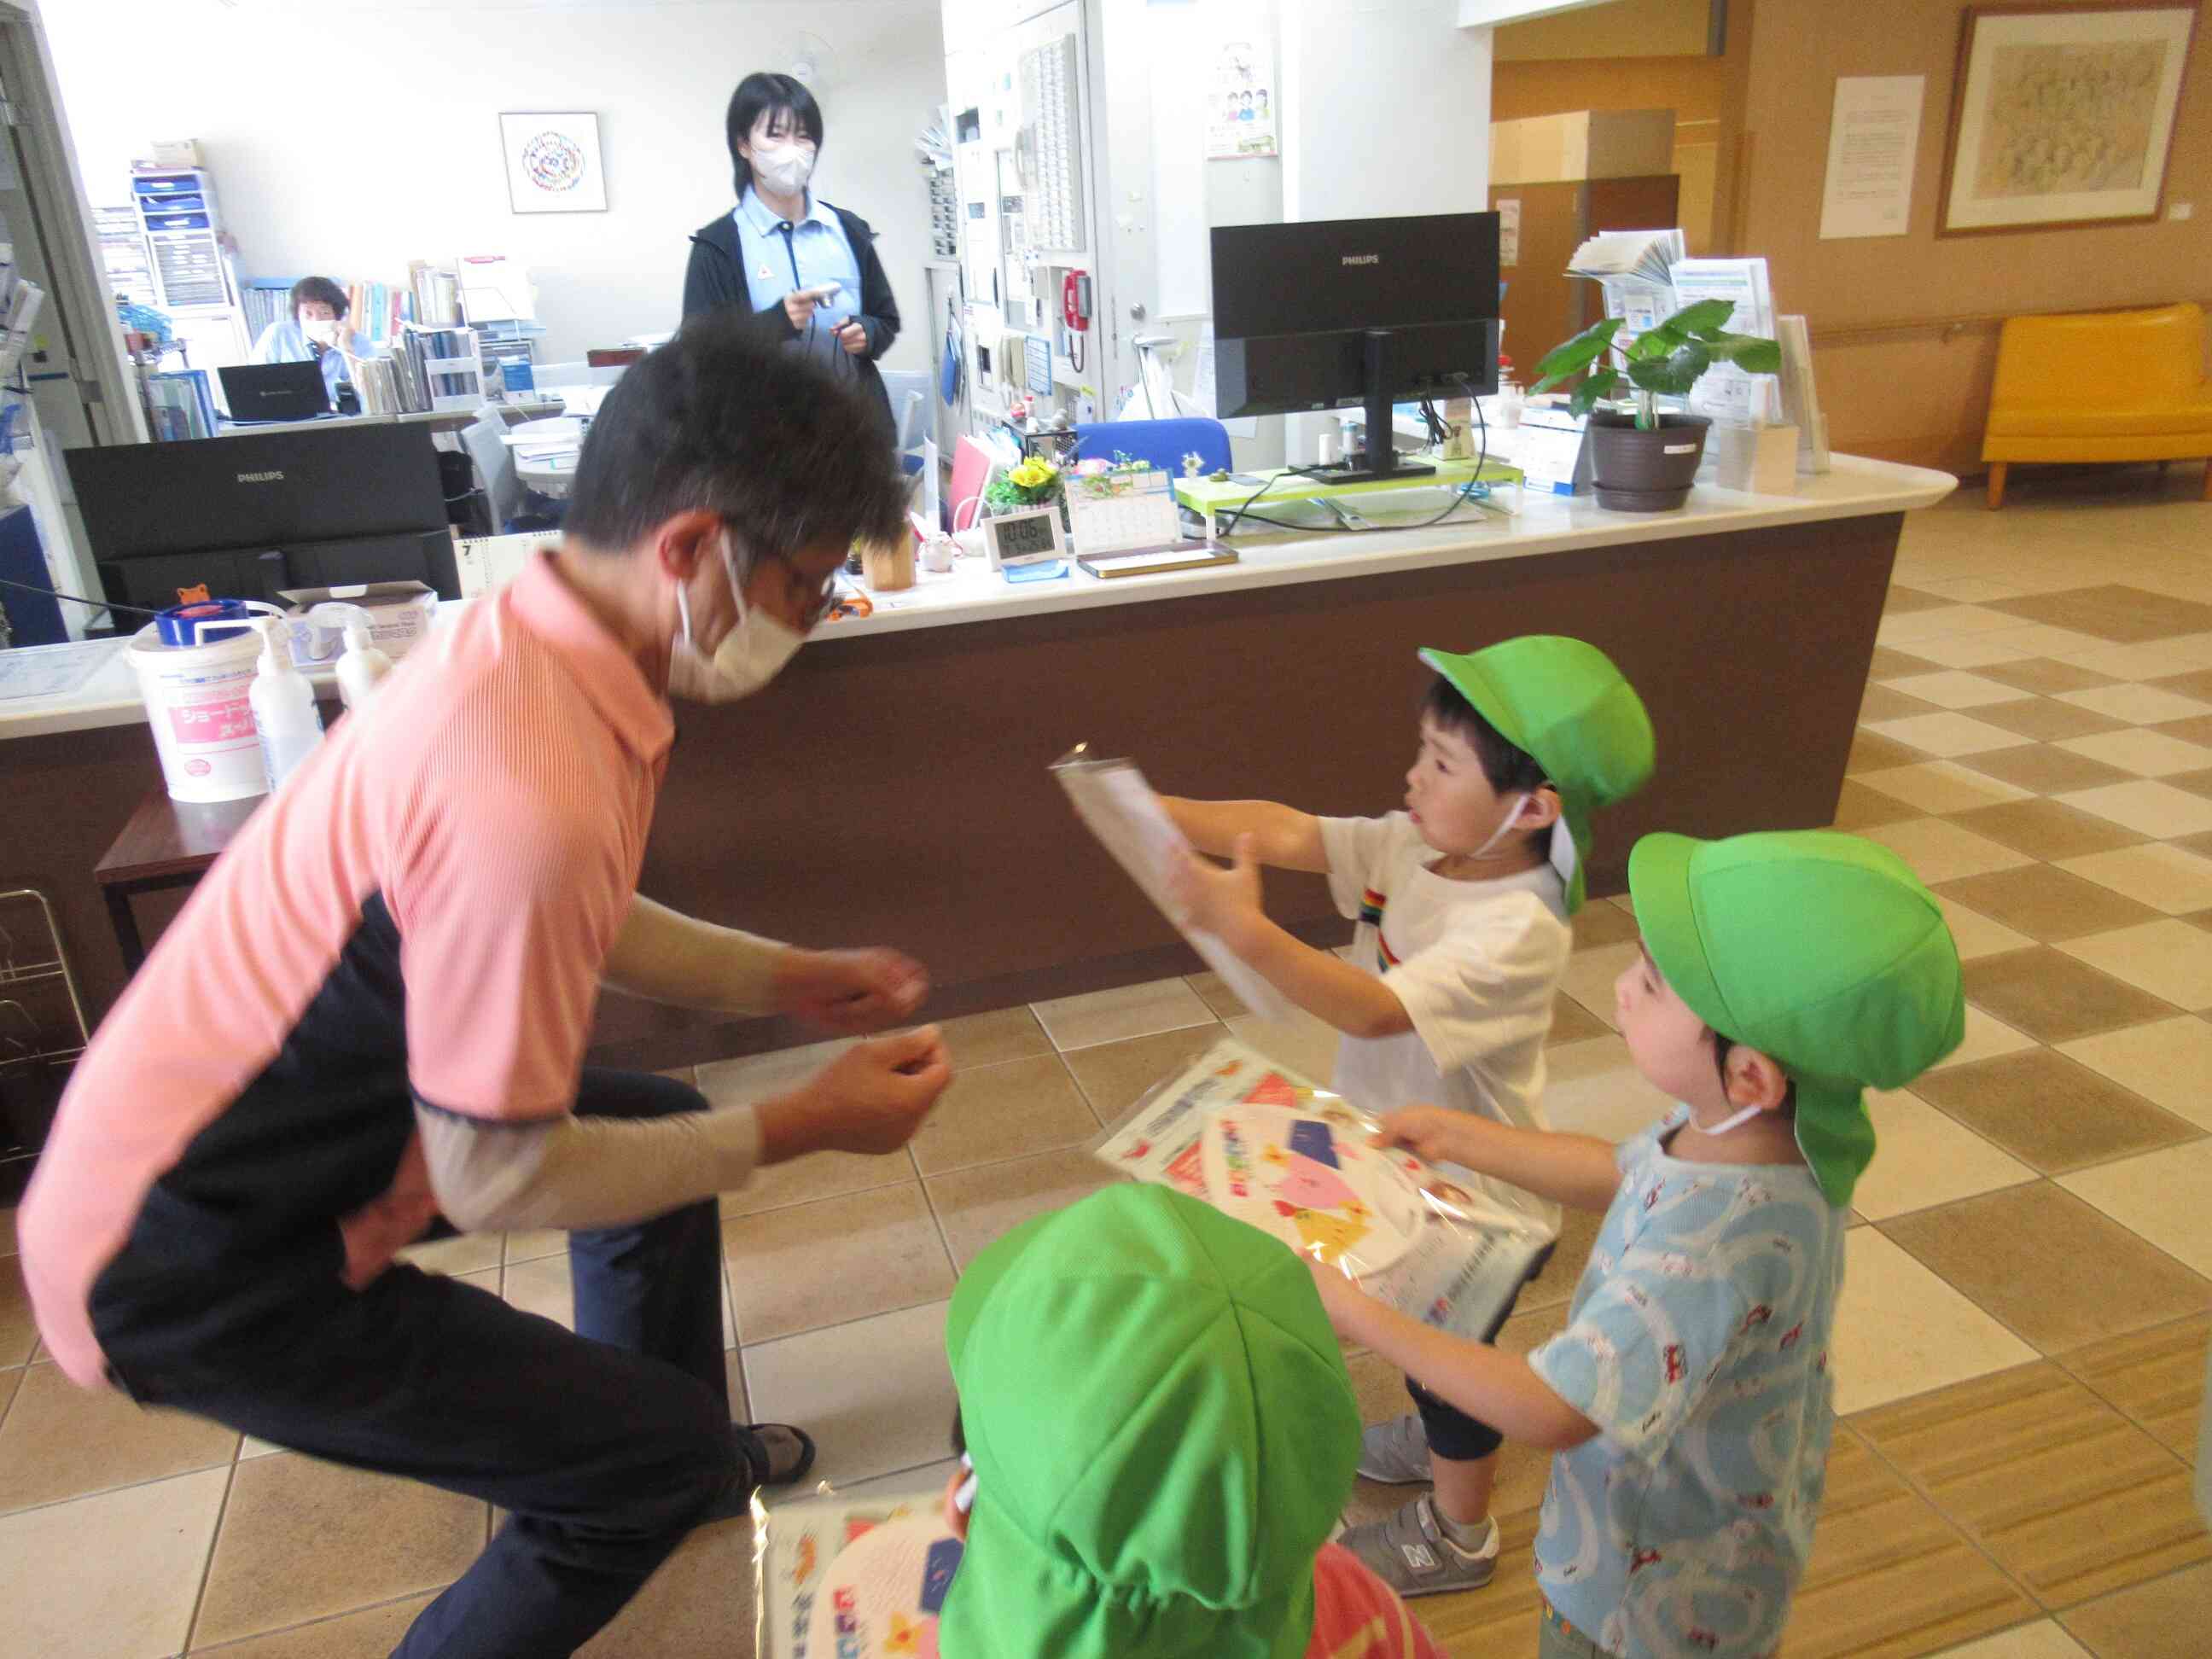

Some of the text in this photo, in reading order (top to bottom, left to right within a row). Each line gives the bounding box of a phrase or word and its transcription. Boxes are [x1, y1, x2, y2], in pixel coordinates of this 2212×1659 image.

[1342, 255, 1378, 265] PHILIPS
[237, 471, 284, 483] PHILIPS
[462, 544, 471, 556] 7
